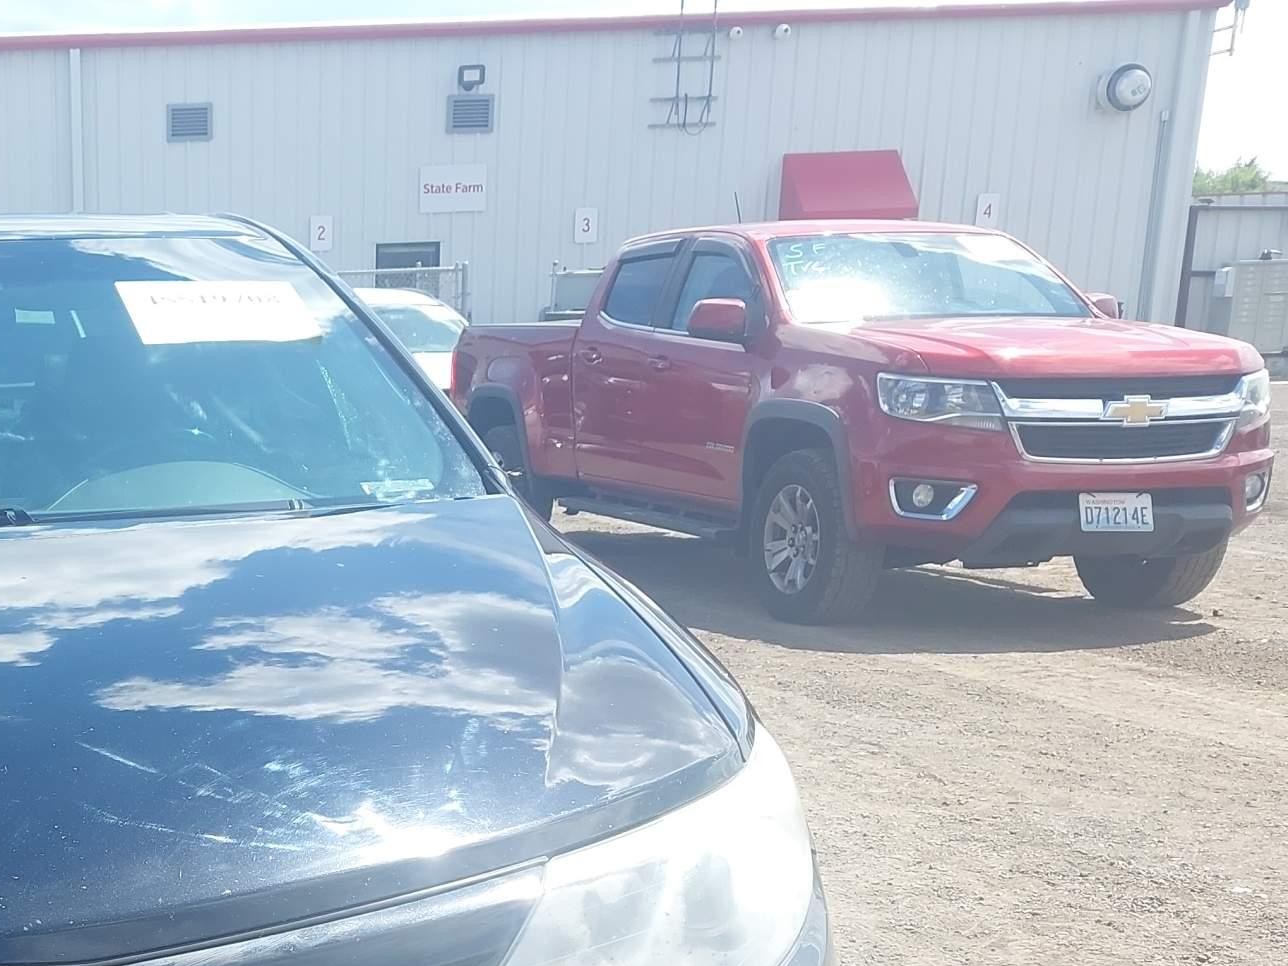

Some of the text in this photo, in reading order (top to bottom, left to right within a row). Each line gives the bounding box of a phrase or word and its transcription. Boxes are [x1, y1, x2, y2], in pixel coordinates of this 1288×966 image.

[423, 182, 484, 194] State Farm
[983, 203, 992, 218] 4
[582, 217, 590, 232] 3
[317, 225, 326, 240] 2
[1085, 506, 1150, 525] D71214E
